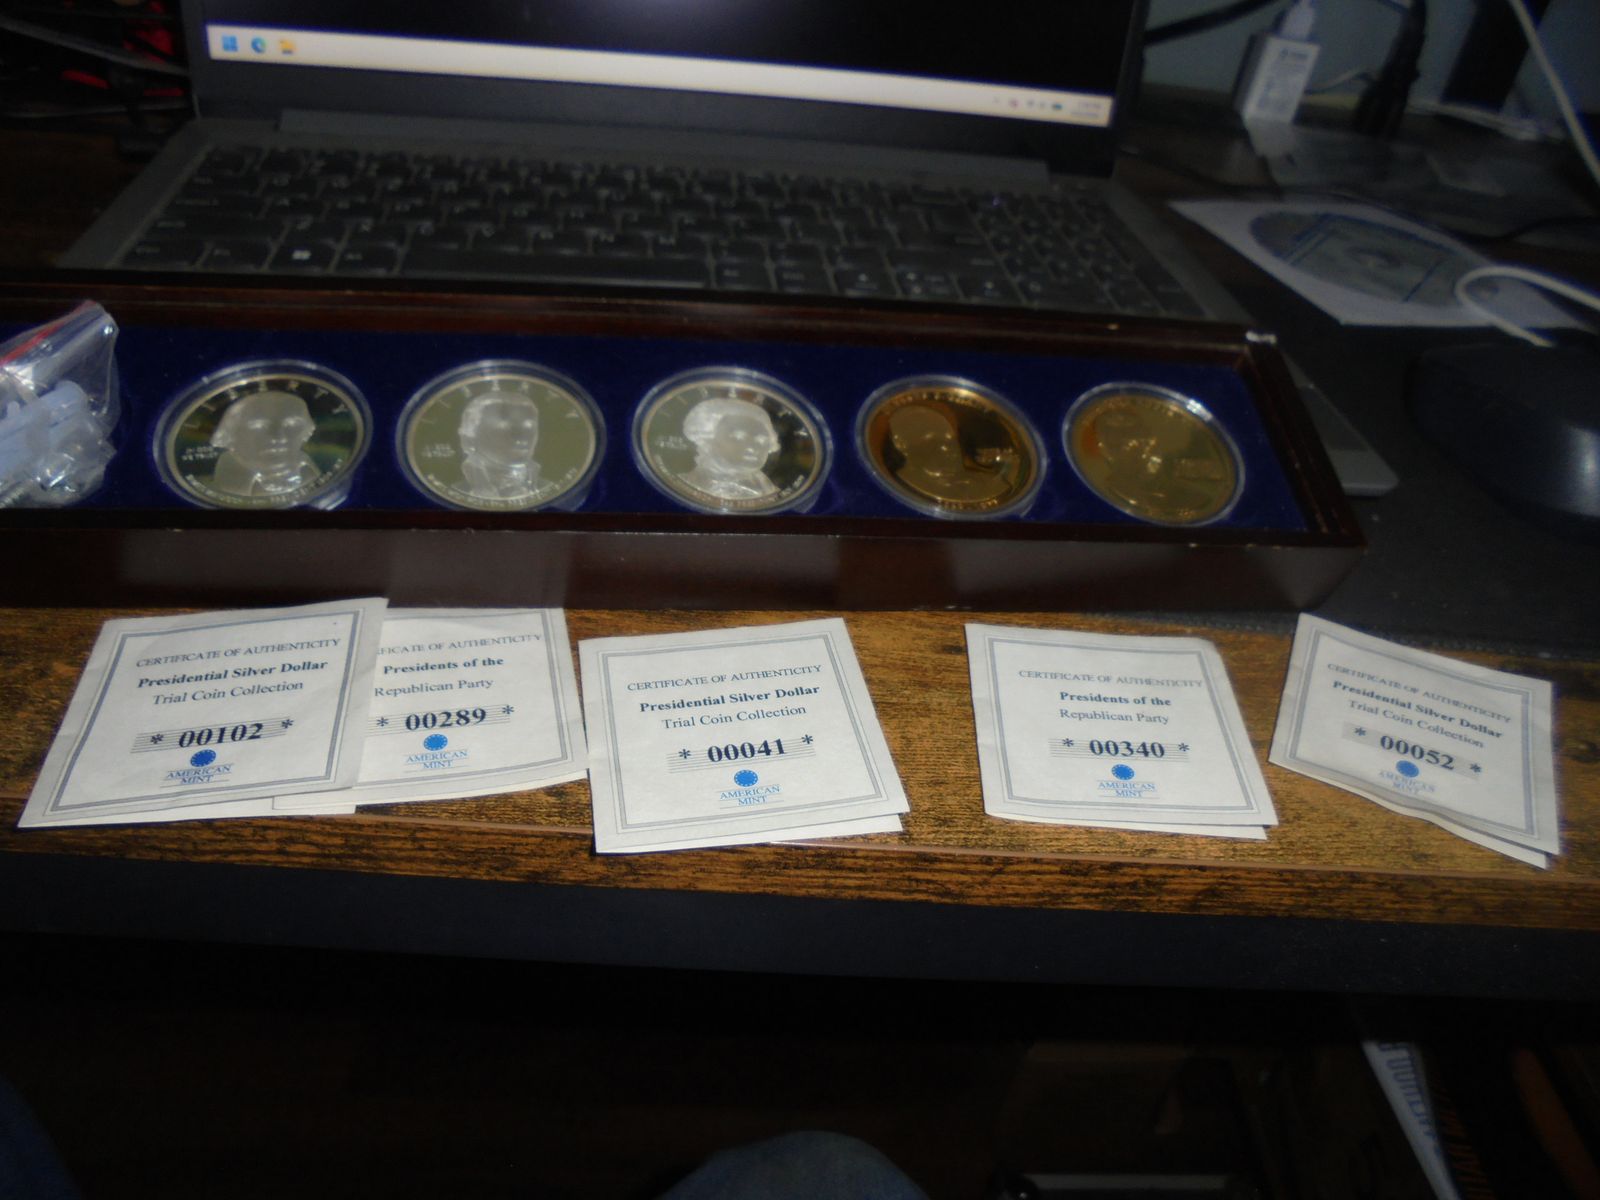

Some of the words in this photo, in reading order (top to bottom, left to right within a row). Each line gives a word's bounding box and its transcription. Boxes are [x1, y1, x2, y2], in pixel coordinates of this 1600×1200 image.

[136, 650, 221, 668] CERTIFICATE
[223, 648, 241, 657] OF
[243, 638, 341, 656] AUTHENTICITY
[376, 644, 425, 656] FICATE
[428, 642, 445, 652] OF
[447, 634, 542, 650] AUTHENTICITY
[137, 670, 228, 688] Presidential
[231, 665, 277, 678] Silver
[280, 660, 328, 673] Dollar
[383, 661, 458, 675] Presidents
[463, 658, 478, 669] of
[482, 656, 504, 667] the
[627, 676, 708, 691] CERTIFICATE
[710, 674, 728, 684] OF
[730, 664, 822, 682] AUTHENTICITY
[1019, 669, 1095, 682] CERTIFICATE
[1097, 674, 1112, 683] OF
[1115, 677, 1202, 688] AUTHENTICITY
[152, 692, 187, 705] Trial
[191, 687, 228, 701] Coin
[230, 680, 304, 697] Collection
[374, 682, 453, 698] Republican
[458, 679, 493, 691] Party
[639, 694, 726, 713] Presidential
[729, 690, 771, 703] Silver
[775, 684, 820, 698] Dollar
[1059, 691, 1130, 705] Presidents
[1133, 694, 1147, 705] of
[1150, 696, 1172, 706] the
[1327, 663, 1402, 690] CERTIFICATE
[1404, 684, 1420, 694] OF
[1422, 691, 1512, 724] AUTHENTICITY
[405, 707, 487, 731] 00289
[661, 715, 696, 729] Trial
[700, 710, 733, 725] Coin
[736, 704, 806, 721] Collection
[1059, 709, 1133, 722] Republican
[1136, 712, 1170, 725] Party
[1332, 680, 1412, 710] Presidential
[1415, 704, 1456, 722] Silver
[1460, 717, 1503, 739] Dollar
[178, 723, 264, 748] 00102
[1349, 701, 1380, 717] Trial
[1383, 709, 1414, 726] Coin
[1417, 720, 1485, 749] Collection
[406, 751, 468, 764] AMERICAN
[706, 738, 787, 763] 00041
[1089, 739, 1165, 759] 00340
[1380, 735, 1455, 771] 00052
[166, 765, 232, 779] AMERICAN
[423, 760, 453, 770] MINT
[179, 775, 215, 785] MINT
[1098, 781, 1156, 791] AMERICAN
[720, 785, 781, 800] AMERICAN
[738, 795, 768, 806] MINT
[1115, 789, 1143, 798] MINT
